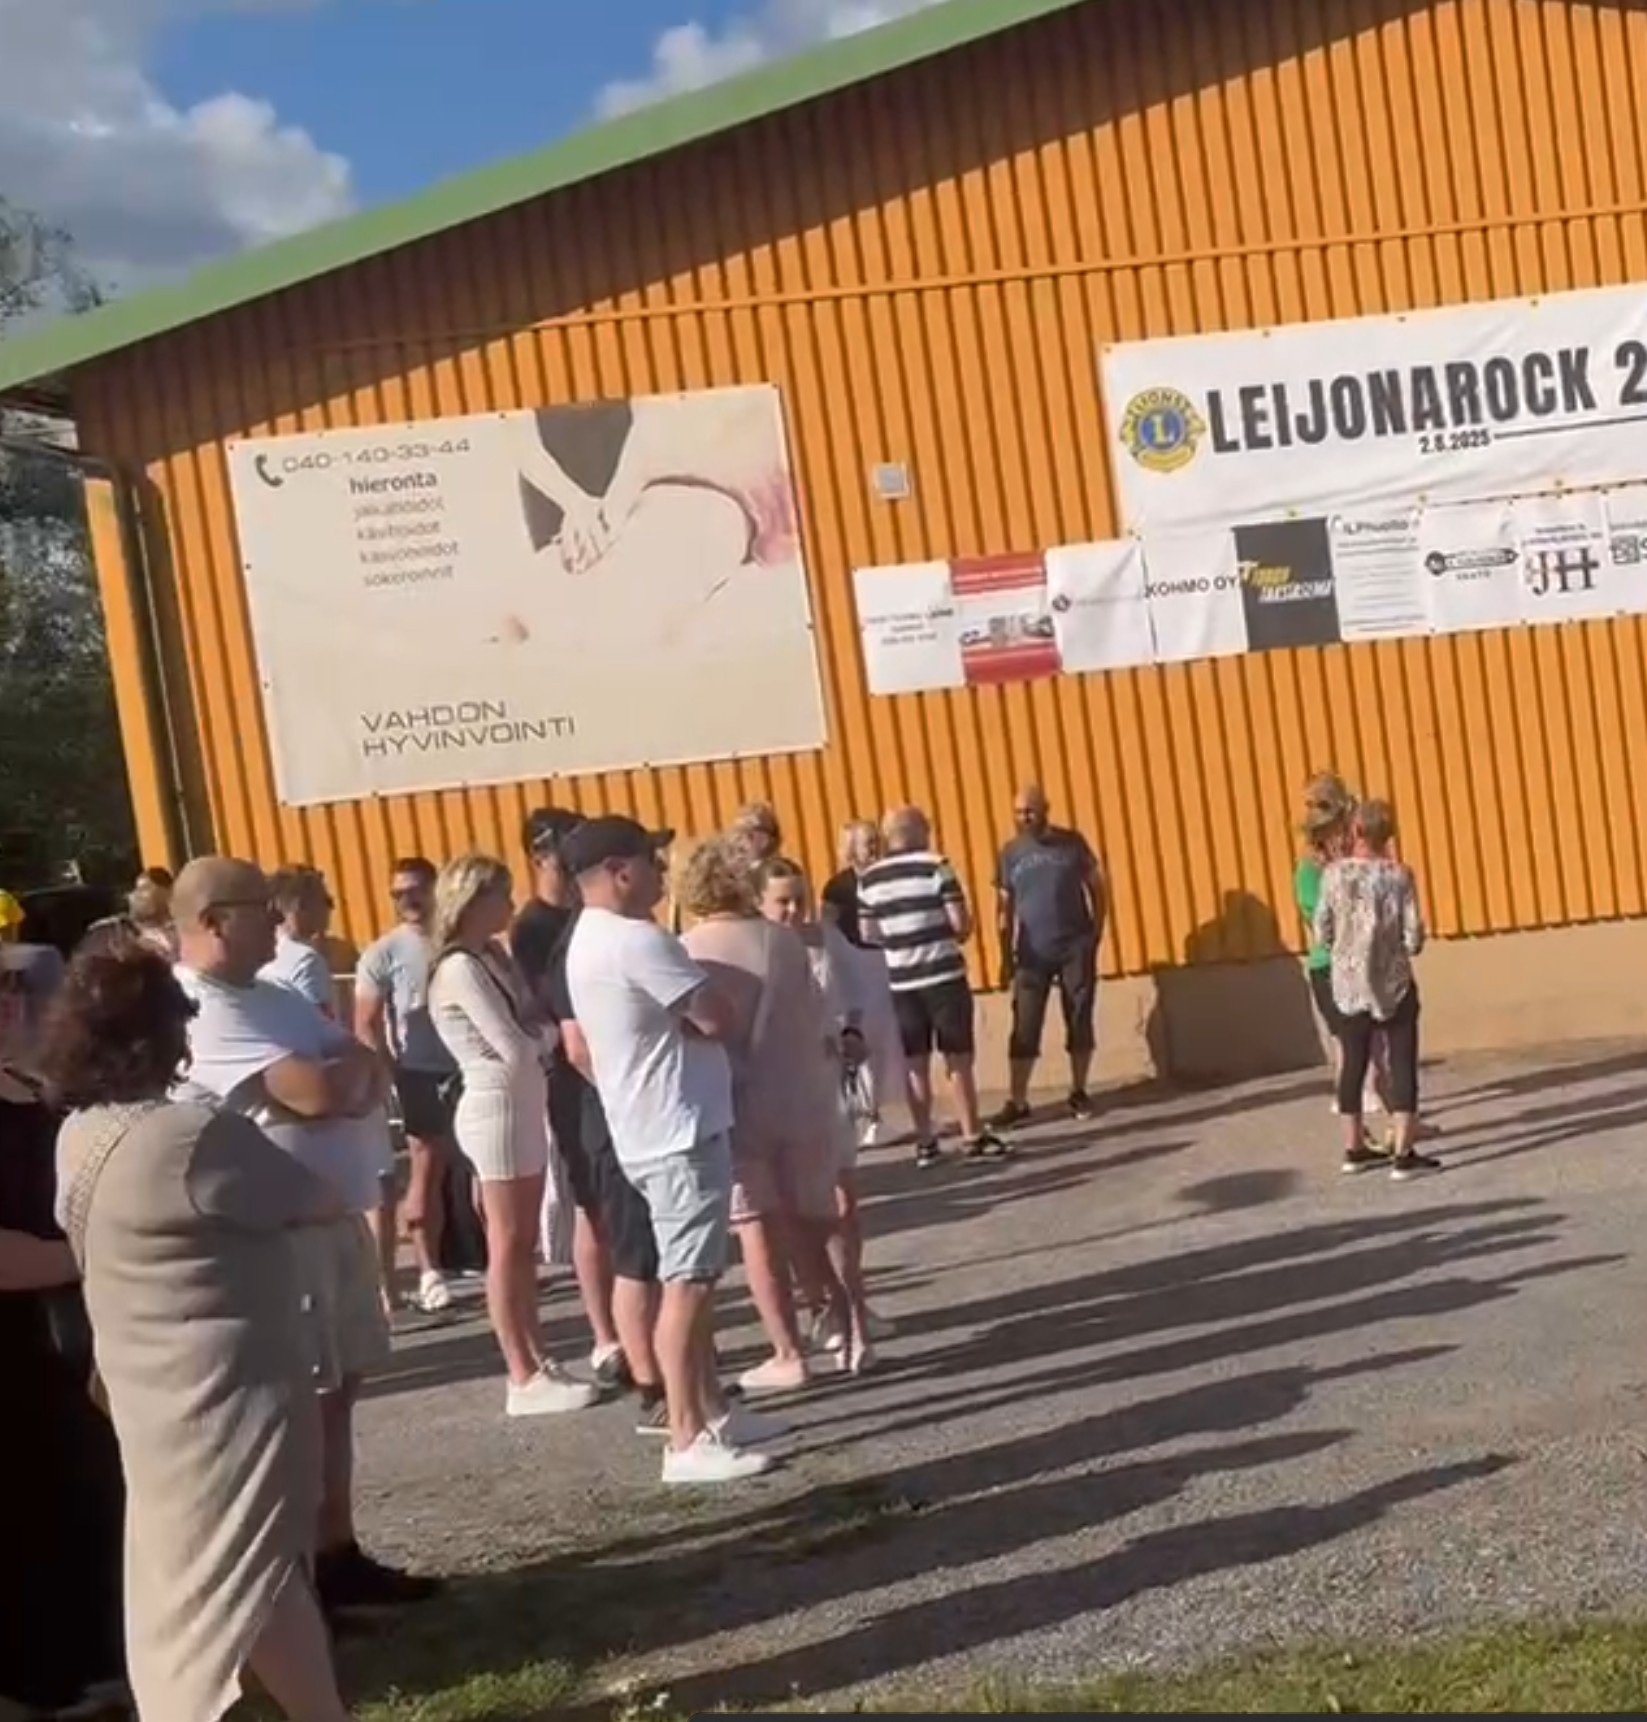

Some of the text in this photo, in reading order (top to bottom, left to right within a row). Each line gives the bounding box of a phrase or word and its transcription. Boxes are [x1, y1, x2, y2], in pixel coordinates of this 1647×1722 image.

[1206, 346, 1597, 454] LEIJONAROCK
[281, 438, 471, 474] 040-140-33-44
[349, 471, 438, 495] hieronta
[1145, 576, 1210, 600] KOHMO
[1213, 574, 1238, 592] OY
[1532, 547, 1600, 597] JH
[360, 698, 506, 735] VAHDON
[362, 715, 576, 757] HYVINVOINTI
